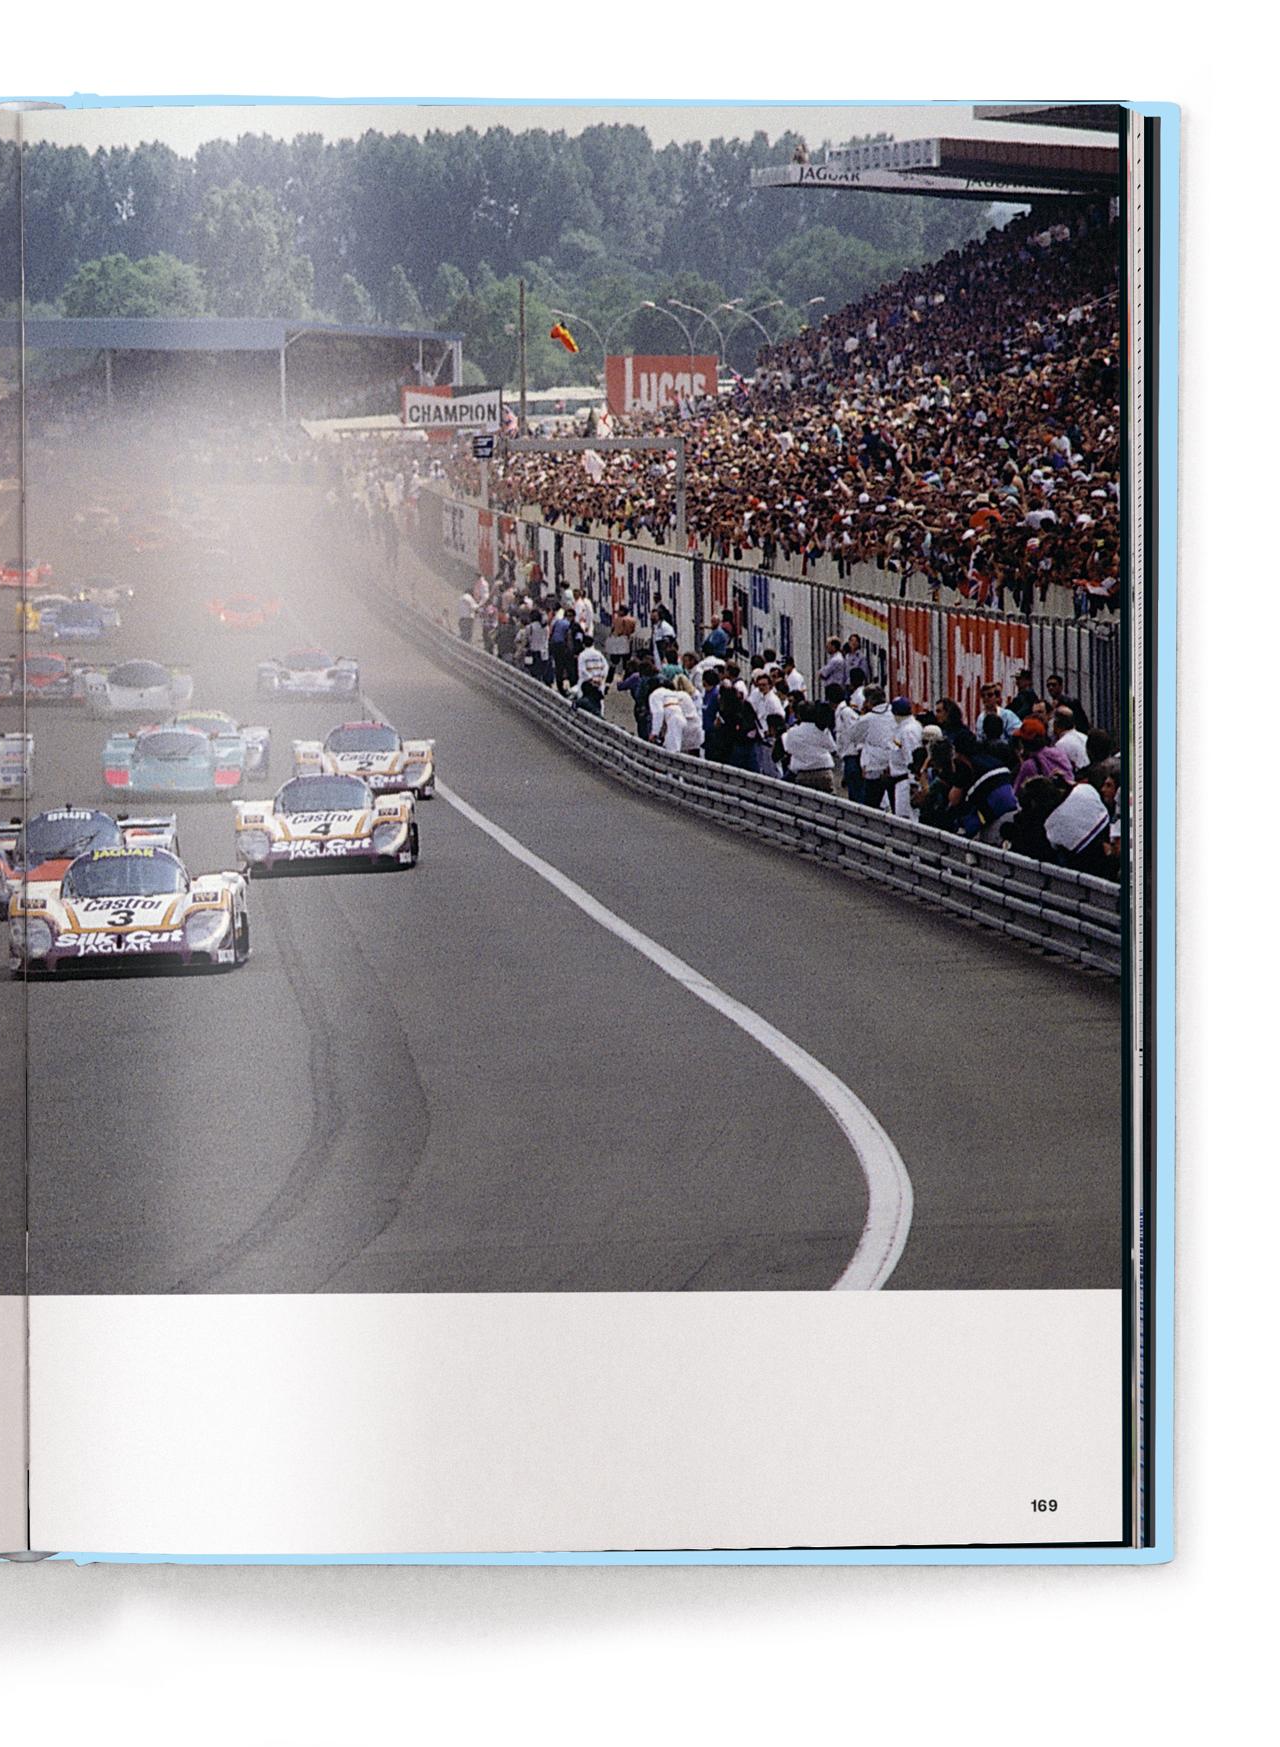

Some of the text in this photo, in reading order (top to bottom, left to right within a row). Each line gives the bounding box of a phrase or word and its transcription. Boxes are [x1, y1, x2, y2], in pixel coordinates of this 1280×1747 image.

[408, 402, 498, 423] CHAMPION
[356, 761, 374, 772] 2
[292, 811, 353, 825] Castrol
[310, 822, 331, 836] 4
[271, 838, 371, 853] Silk Cut
[92, 847, 155, 861] JAGUAR
[289, 847, 348, 860] JAGUAR
[83, 897, 162, 913] Castrol
[107, 910, 135, 927] 3
[55, 929, 184, 949] Silk Cut
[79, 941, 153, 957] JAGUAR
[1030, 1498, 1059, 1513] 169
